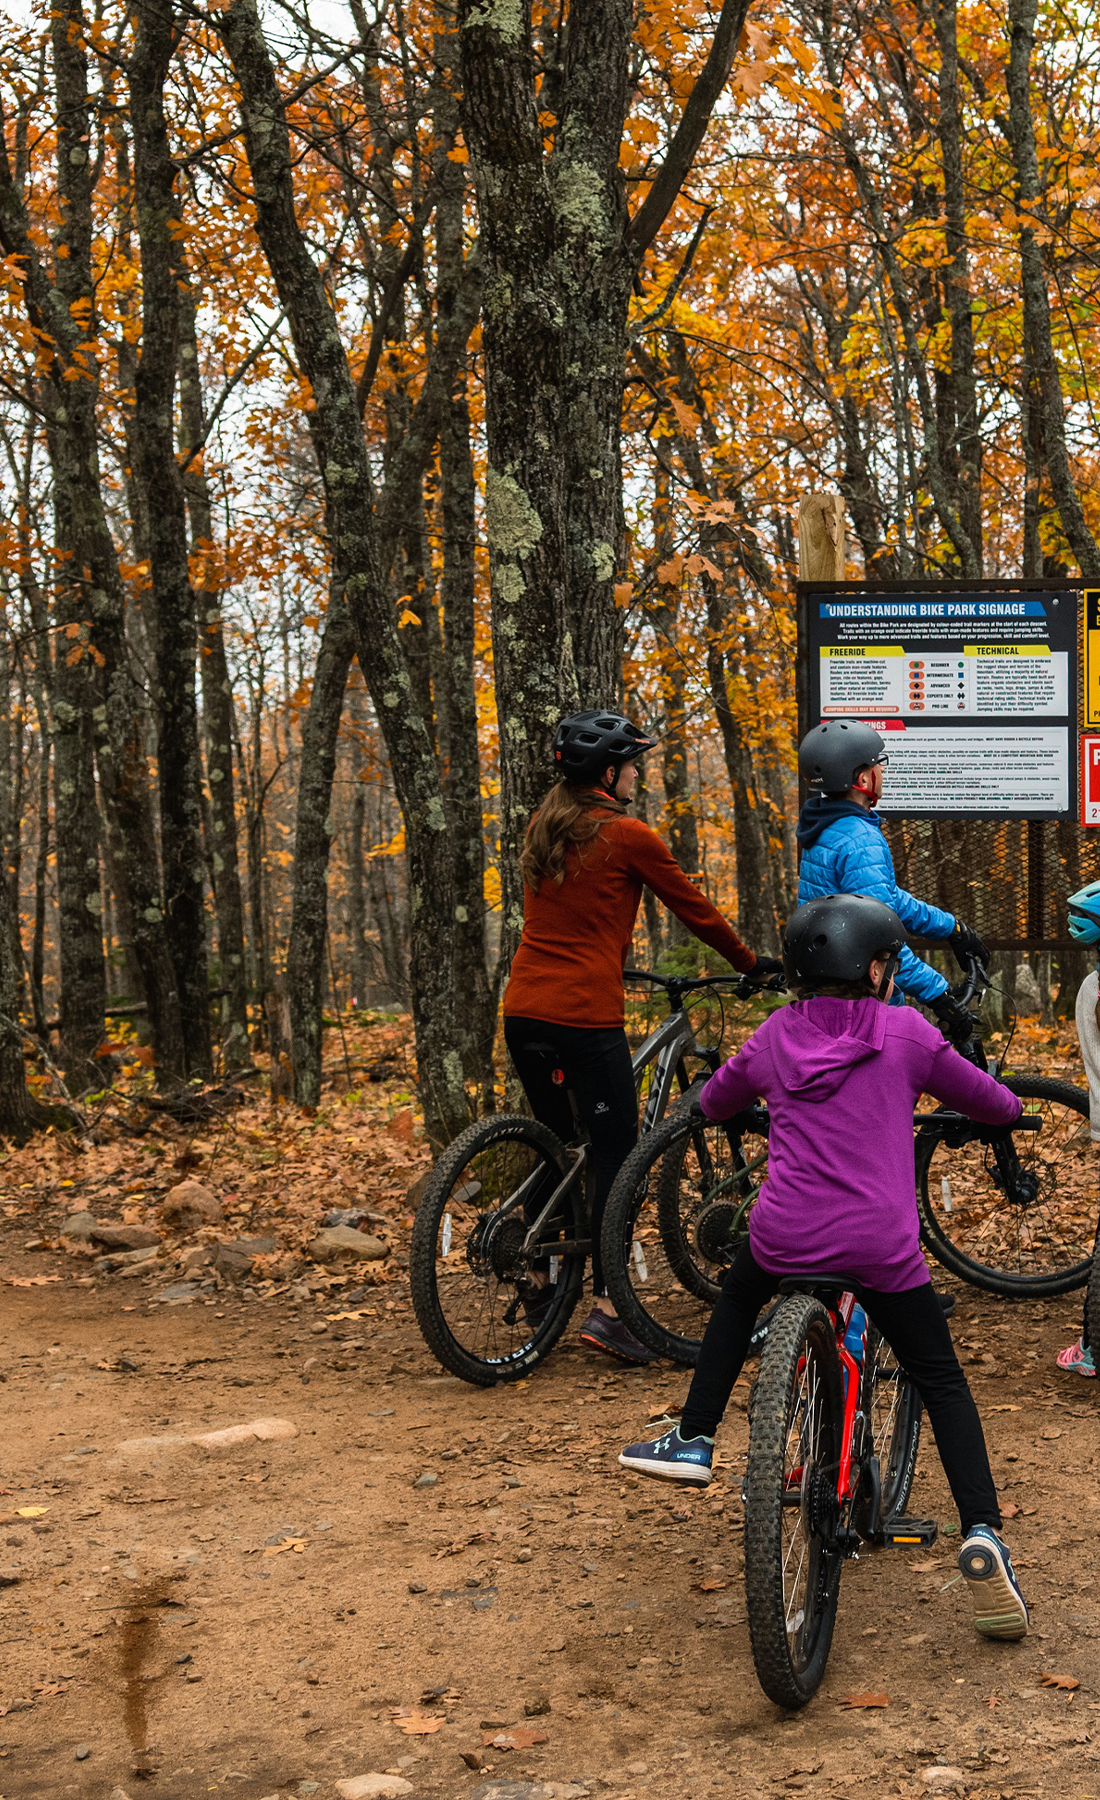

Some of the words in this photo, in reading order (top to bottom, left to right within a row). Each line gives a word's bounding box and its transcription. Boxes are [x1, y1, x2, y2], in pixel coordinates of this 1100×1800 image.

[830, 605, 916, 616] UNDERSTANDING
[920, 604, 944, 615] BIKE
[948, 604, 976, 615] PARK
[979, 604, 1025, 615] SIGNAGE
[830, 648, 866, 656] FREERIDE
[977, 647, 1019, 655] TECHNICAL
